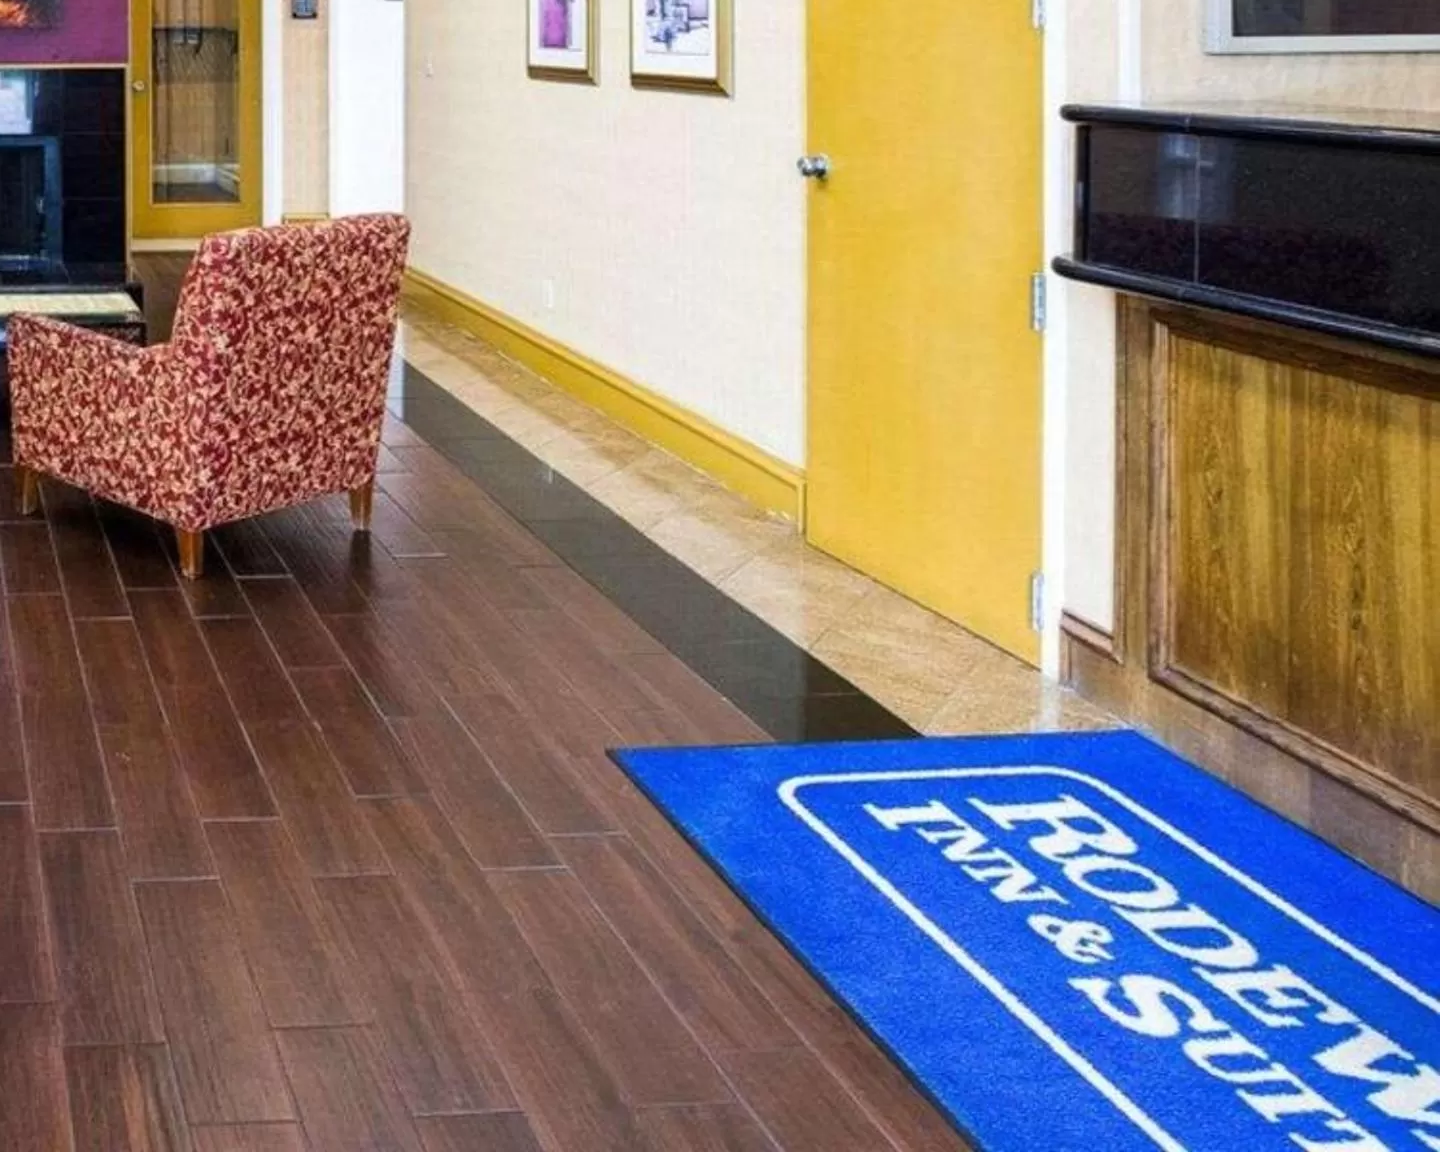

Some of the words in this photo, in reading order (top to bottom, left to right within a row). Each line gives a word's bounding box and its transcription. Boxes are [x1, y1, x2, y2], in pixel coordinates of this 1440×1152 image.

[864, 799, 1068, 905] INN
[1026, 912, 1116, 965] &
[967, 794, 1440, 1152] RODEW
